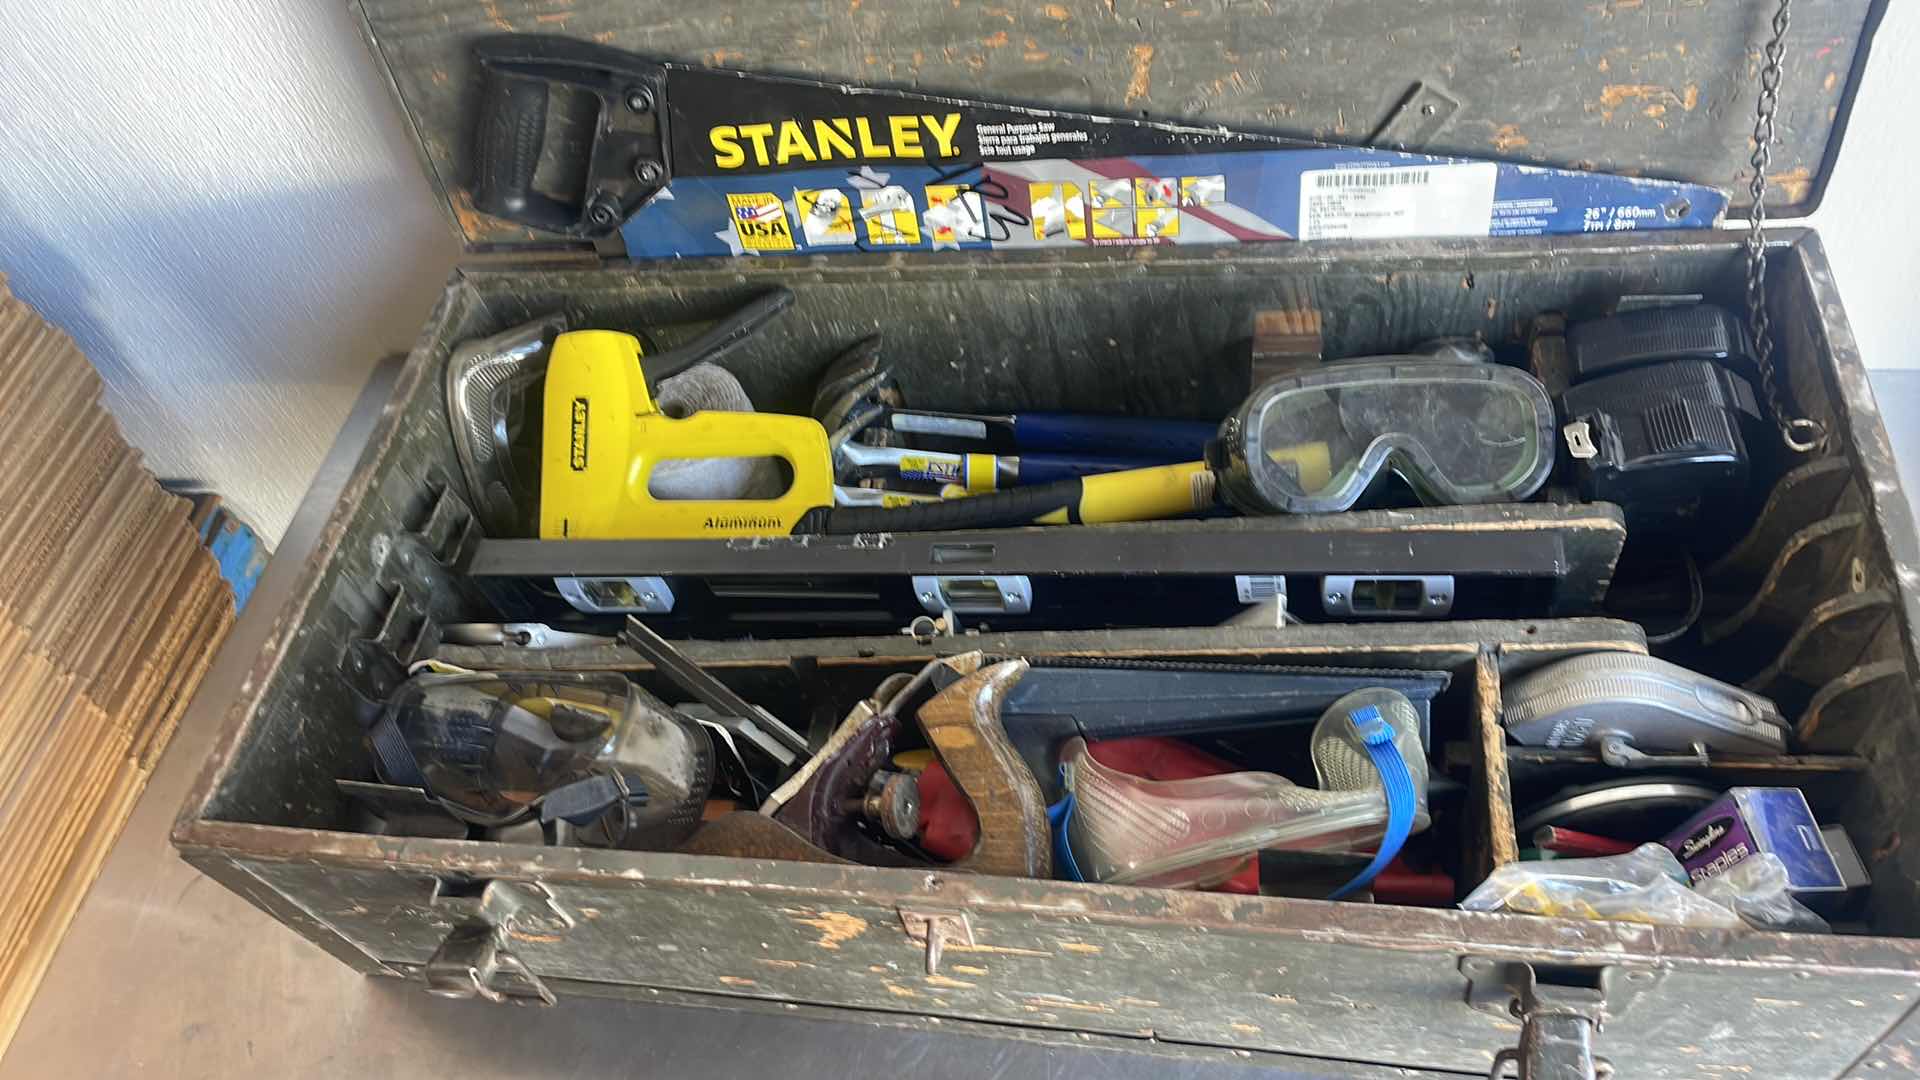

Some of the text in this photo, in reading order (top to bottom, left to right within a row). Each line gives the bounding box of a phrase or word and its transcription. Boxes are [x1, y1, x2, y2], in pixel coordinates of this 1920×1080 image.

[1006, 123, 1037, 134] Purpose
[1038, 121, 1055, 132] Saw
[709, 113, 961, 168] STANLEY
[1617, 205, 1657, 218] 660mm
[740, 222, 787, 236] USA
[571, 399, 587, 469] STANLEY
[703, 516, 782, 530] Aluminum
